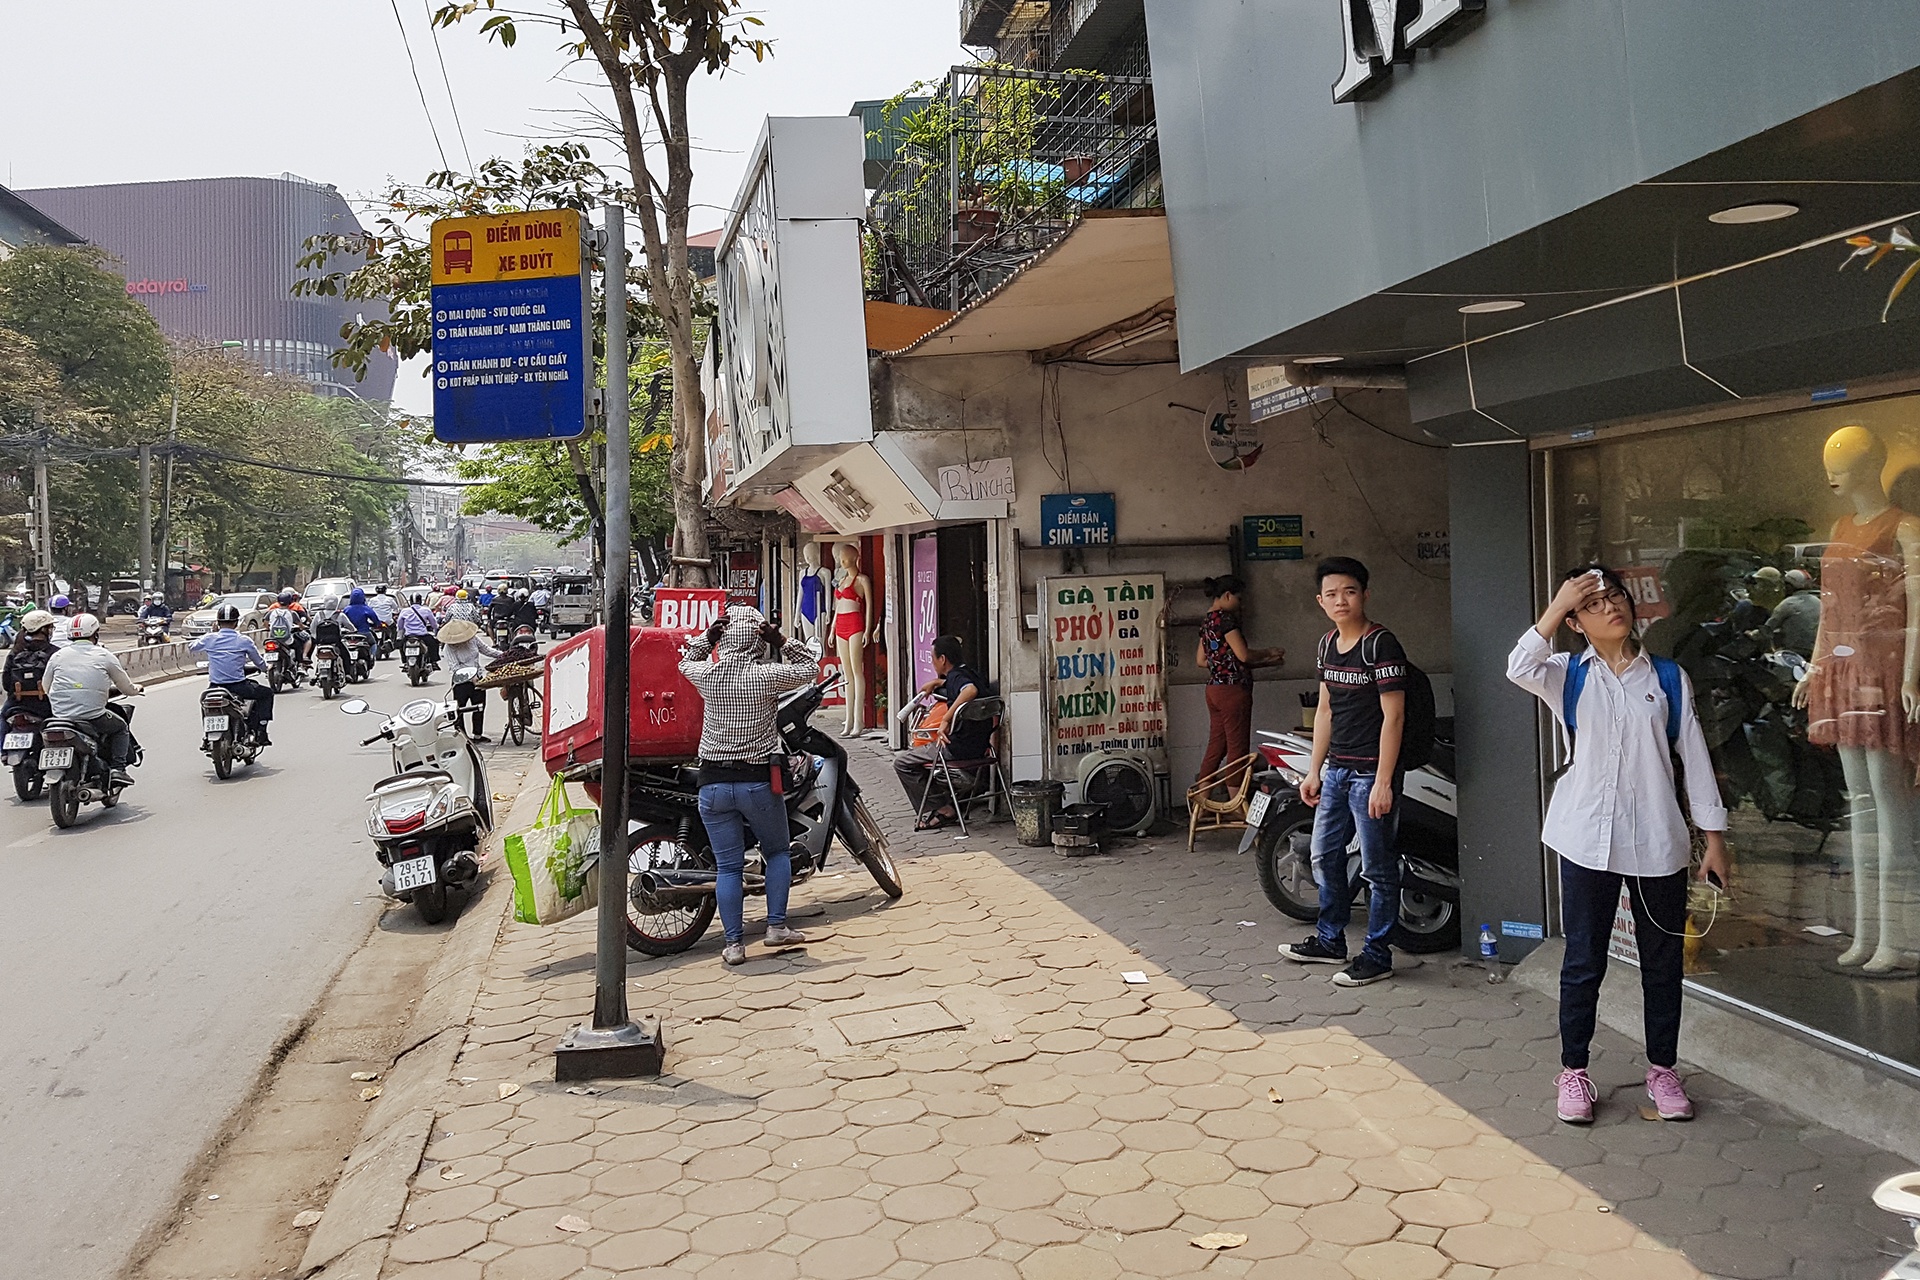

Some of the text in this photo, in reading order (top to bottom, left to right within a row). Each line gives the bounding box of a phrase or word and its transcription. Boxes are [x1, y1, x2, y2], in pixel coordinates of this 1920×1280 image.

[486, 219, 562, 244] ĐIỂM DỪNG
[499, 249, 554, 273] XE BUÝT
[448, 310, 464, 320] MAI
[465, 307, 487, 320] ĐỘNG
[510, 303, 531, 316] QUỐC
[532, 304, 546, 315] GIA
[468, 323, 493, 337] KHÁNH
[509, 323, 526, 334] NAM
[552, 319, 571, 330] LONG
[471, 357, 498, 370] KHÁNH
[500, 356, 512, 367] DƯ
[518, 356, 529, 367] CV
[548, 351, 567, 365] GIẤY
[462, 374, 480, 386] PHÁP
[524, 372, 533, 382] BX
[534, 370, 547, 382] YÊN
[1057, 509, 1099, 525] ĐIỂM BÁN
[1048, 528, 1073, 545] SIM
[1083, 521, 1109, 544] THẺ
[730, 569, 758, 588] NEW
[1058, 580, 1154, 605] GÀ TẦN
[661, 594, 719, 630] BÚN
[1054, 604, 1139, 642] PHỞ BÒ
[1118, 625, 1139, 639] GÀ
[1056, 647, 1105, 680] BÚN
[1120, 664, 1143, 677] LÒNG
[1120, 685, 1145, 697] NGAN
[1120, 701, 1144, 713] LÒNG
[1087, 723, 1105, 736] TIM
[399, 859, 428, 876] 29-E2
[399, 870, 432, 888] 161.21
